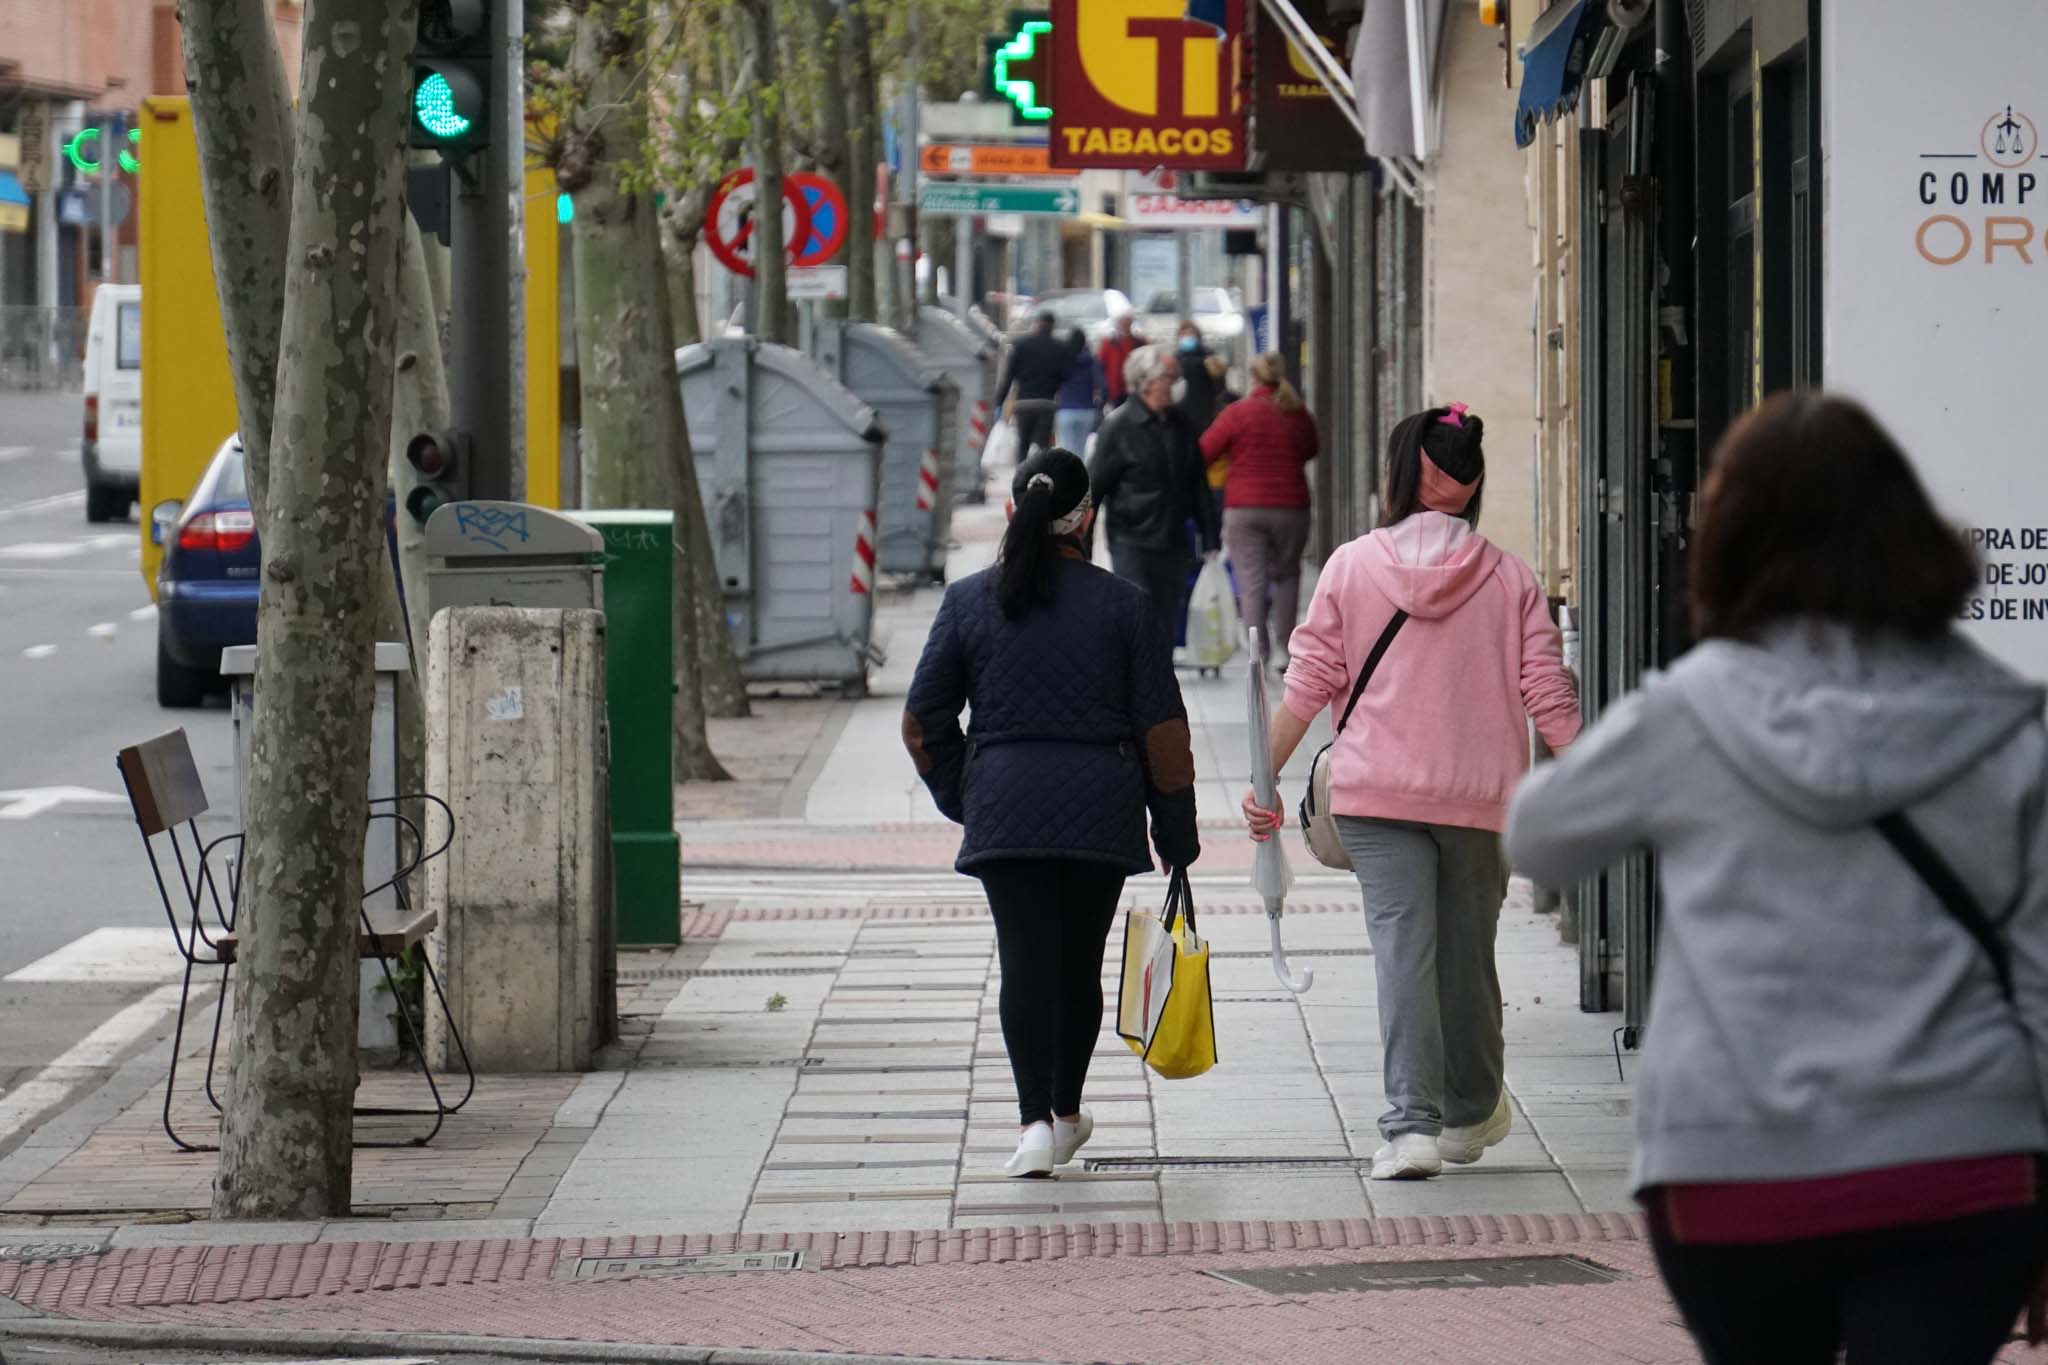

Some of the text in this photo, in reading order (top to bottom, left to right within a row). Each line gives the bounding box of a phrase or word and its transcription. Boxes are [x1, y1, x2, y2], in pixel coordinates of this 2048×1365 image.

[1062, 128, 1233, 155] TABACOS
[1915, 214, 2048, 266] OR
[2020, 527, 2048, 550] DE
[1985, 563, 2048, 586] DE JO
[1990, 598, 2018, 621] DE
[2023, 598, 2048, 621] IN
